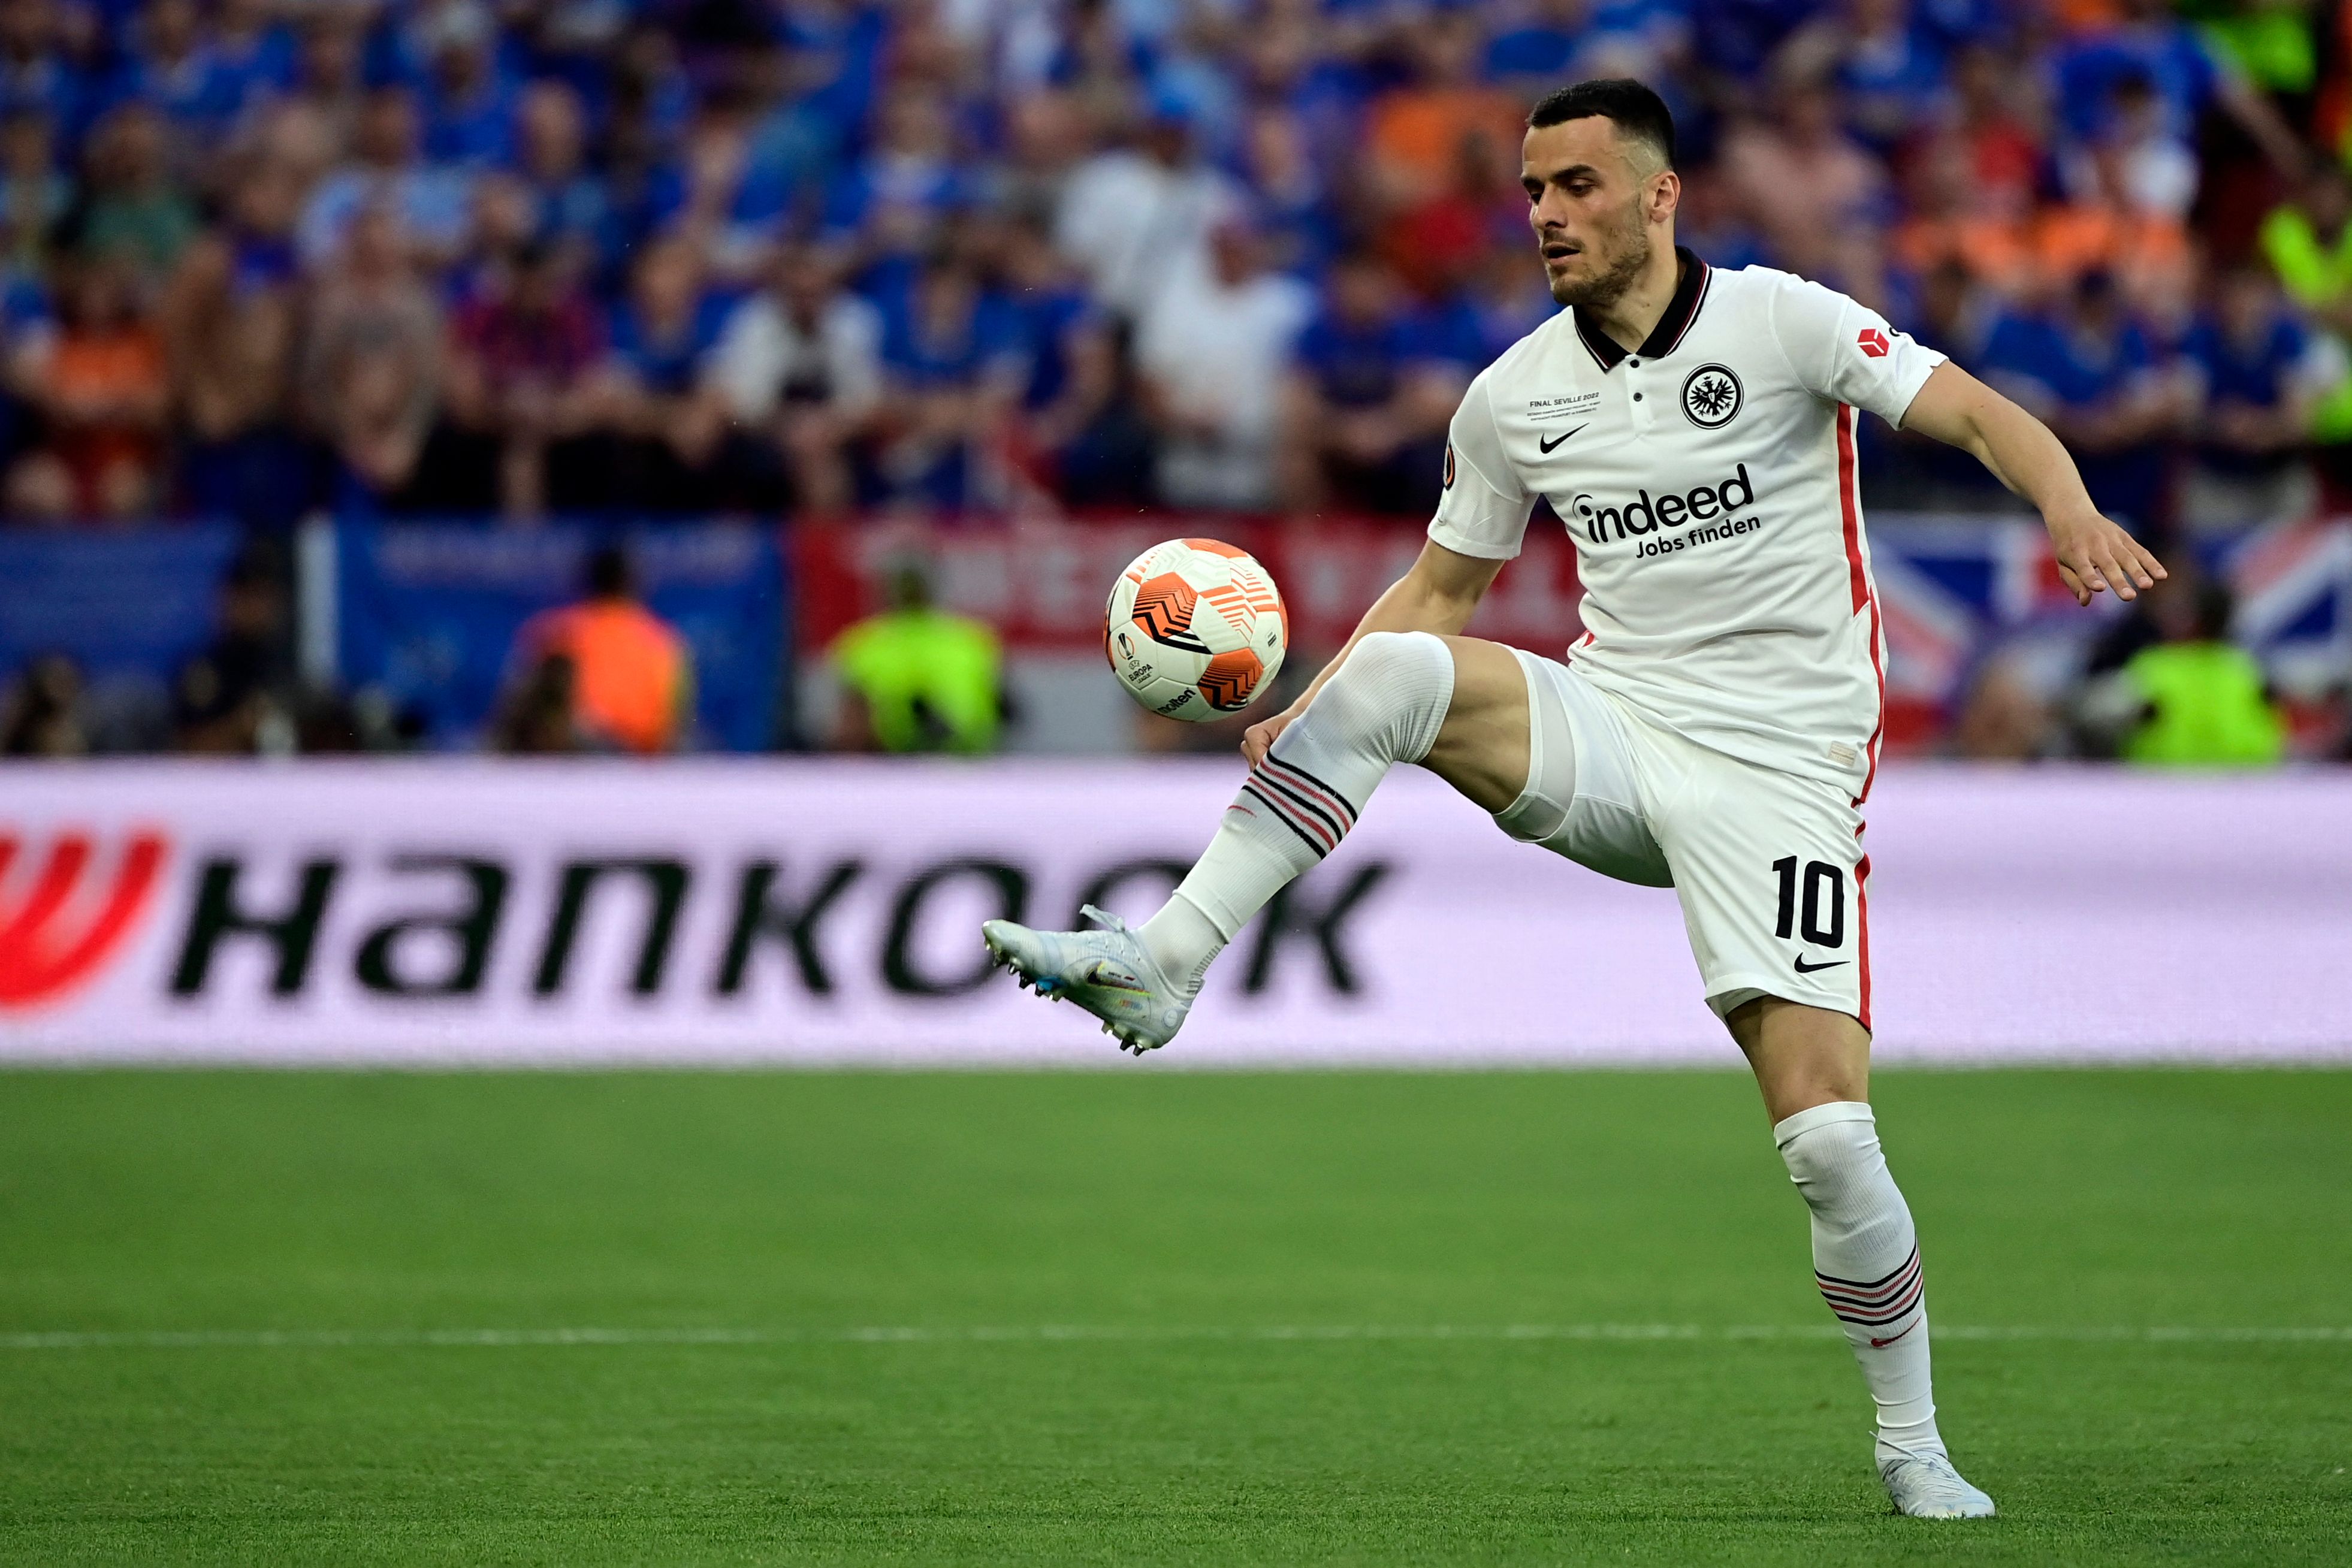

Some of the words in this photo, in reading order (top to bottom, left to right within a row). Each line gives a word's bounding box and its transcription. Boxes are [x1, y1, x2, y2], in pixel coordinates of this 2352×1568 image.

[1554, 395, 1582, 406] SEVILLE
[1583, 392, 1599, 400] 2022
[1572, 463, 1754, 543] indeed
[1636, 536, 1684, 558] Jobs
[1688, 516, 1761, 546] finden
[1128, 664, 1153, 681] EUROPA
[1157, 689, 1196, 713] molten
[1772, 856, 1844, 948] 10
